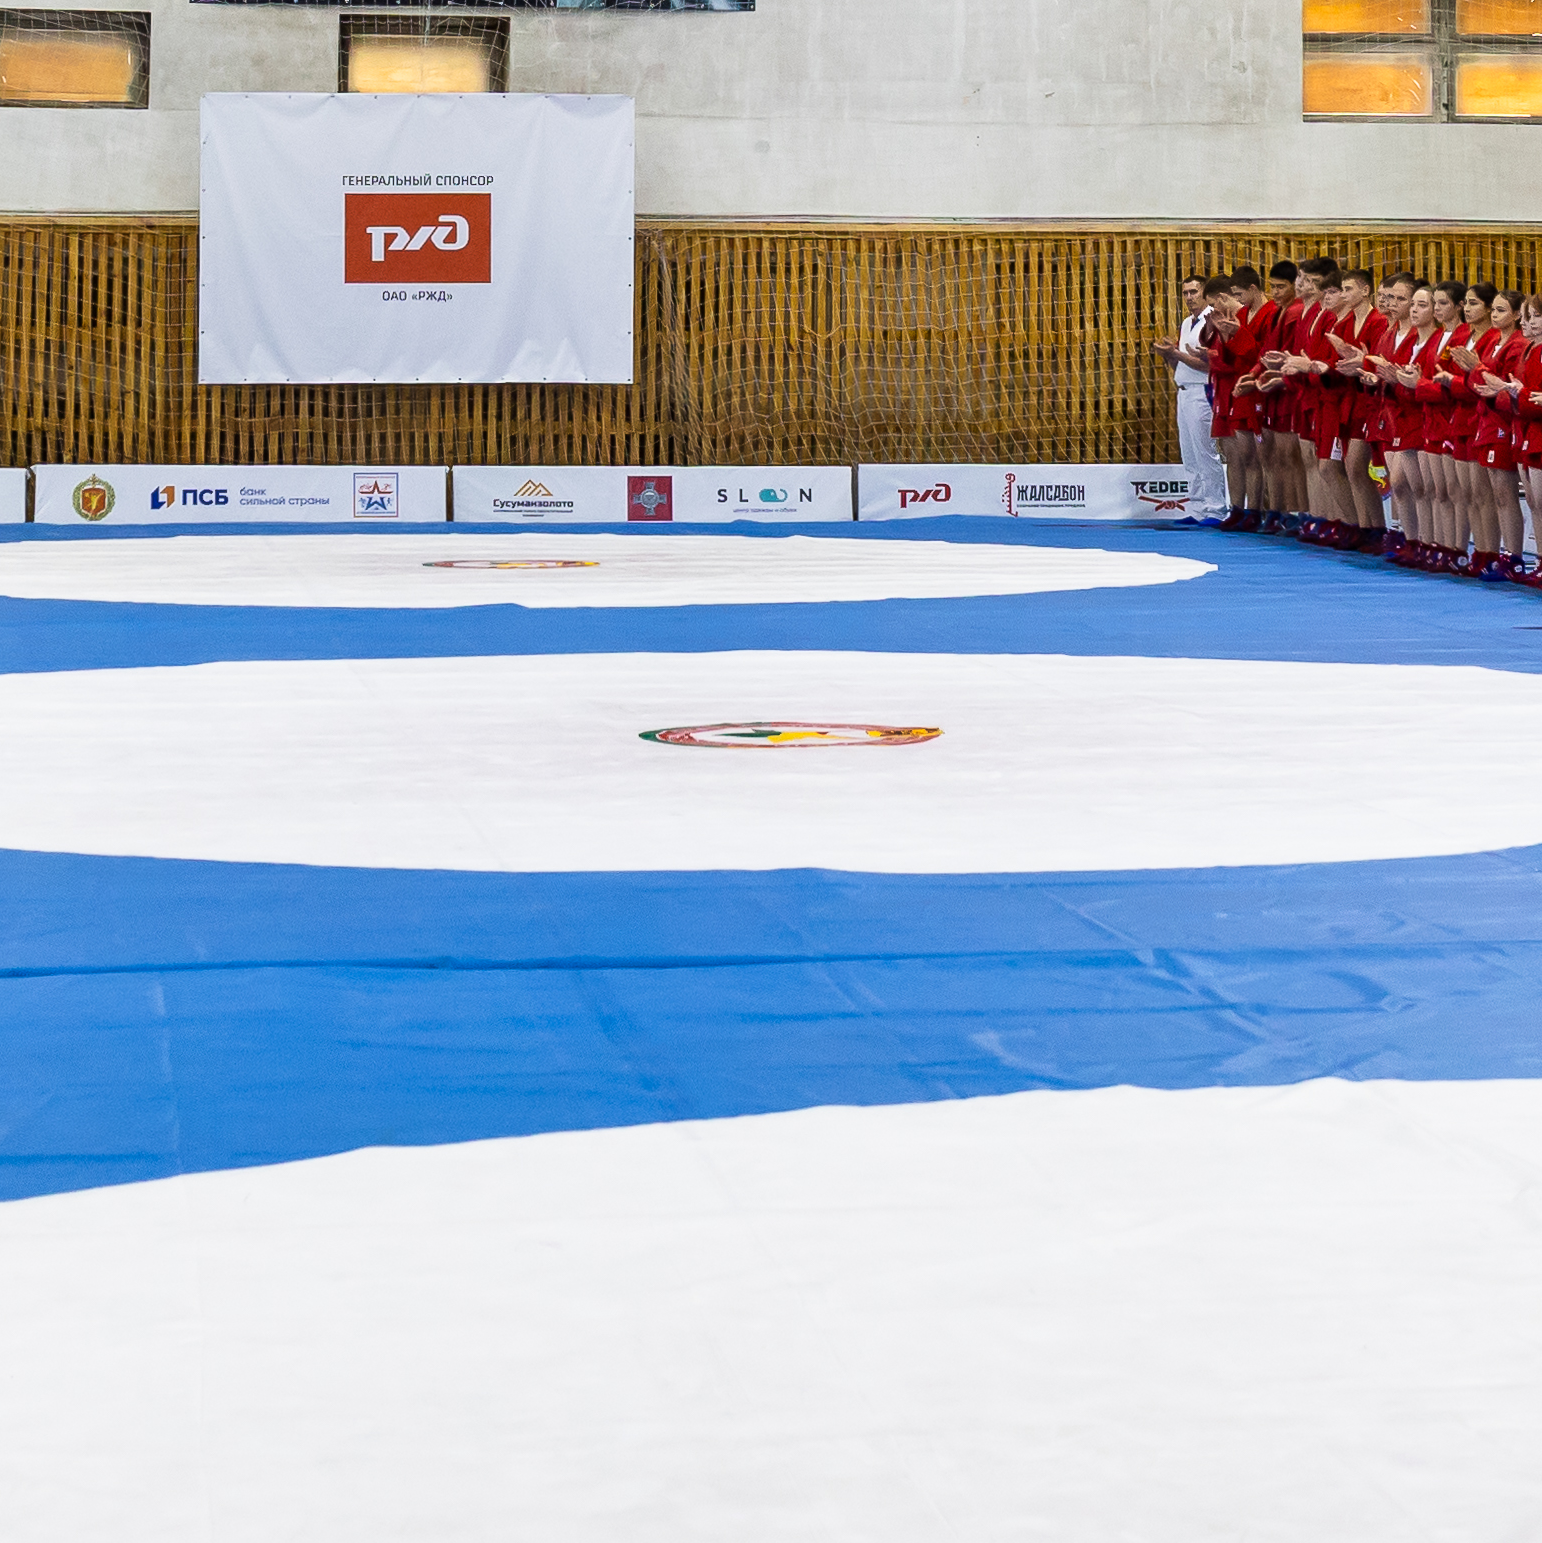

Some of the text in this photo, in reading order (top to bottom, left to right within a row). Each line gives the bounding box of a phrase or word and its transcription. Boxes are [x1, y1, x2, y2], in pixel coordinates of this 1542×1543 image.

[342, 173, 494, 186] ГЕНЕРАЛЬНЫЙ СПОНСОР
[382, 290, 453, 302] ОАО «РЖД»
[181, 488, 229, 506] ПСБ
[239, 487, 267, 496] банк
[1016, 484, 1085, 501] ЖАЛСАБОН
[239, 495, 330, 507] сильной страны
[493, 499, 574, 508] Сусуманзолото
